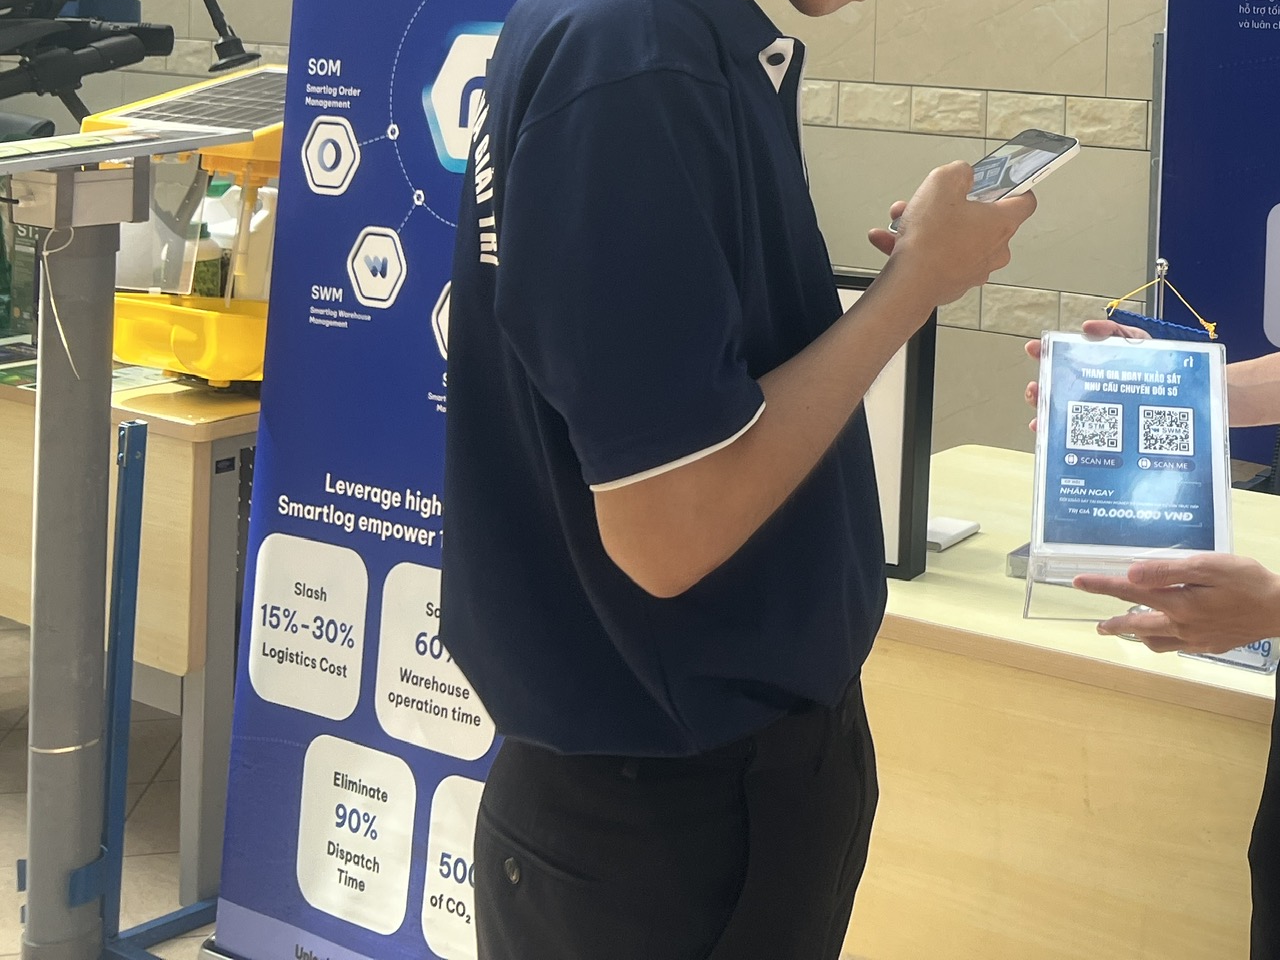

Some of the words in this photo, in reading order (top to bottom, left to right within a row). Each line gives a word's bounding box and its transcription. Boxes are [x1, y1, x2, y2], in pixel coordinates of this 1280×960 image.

[308, 58, 341, 76] SOM
[311, 285, 343, 302] SWM
[1080, 456, 1101, 465] SCAN
[1153, 460, 1174, 468] SCAN
[1176, 461, 1189, 470] ME
[325, 473, 401, 510] Leverage
[405, 489, 441, 518] high
[278, 495, 355, 532] Smartlog
[358, 516, 436, 546] empower
[1092, 507, 1162, 520] 10.000.000
[1164, 511, 1193, 521] VNĐ
[294, 582, 327, 602] Slash
[262, 642, 317, 669] Logistics
[319, 657, 347, 678] Cost
[400, 667, 470, 703] Warehouse
[388, 692, 448, 719] operation
[451, 707, 481, 727] time
[333, 771, 388, 803] Eliminate
[335, 803, 377, 840] 90%
[327, 840, 379, 873] Dispatch
[337, 868, 365, 892] Time
[430, 894, 444, 909] of
